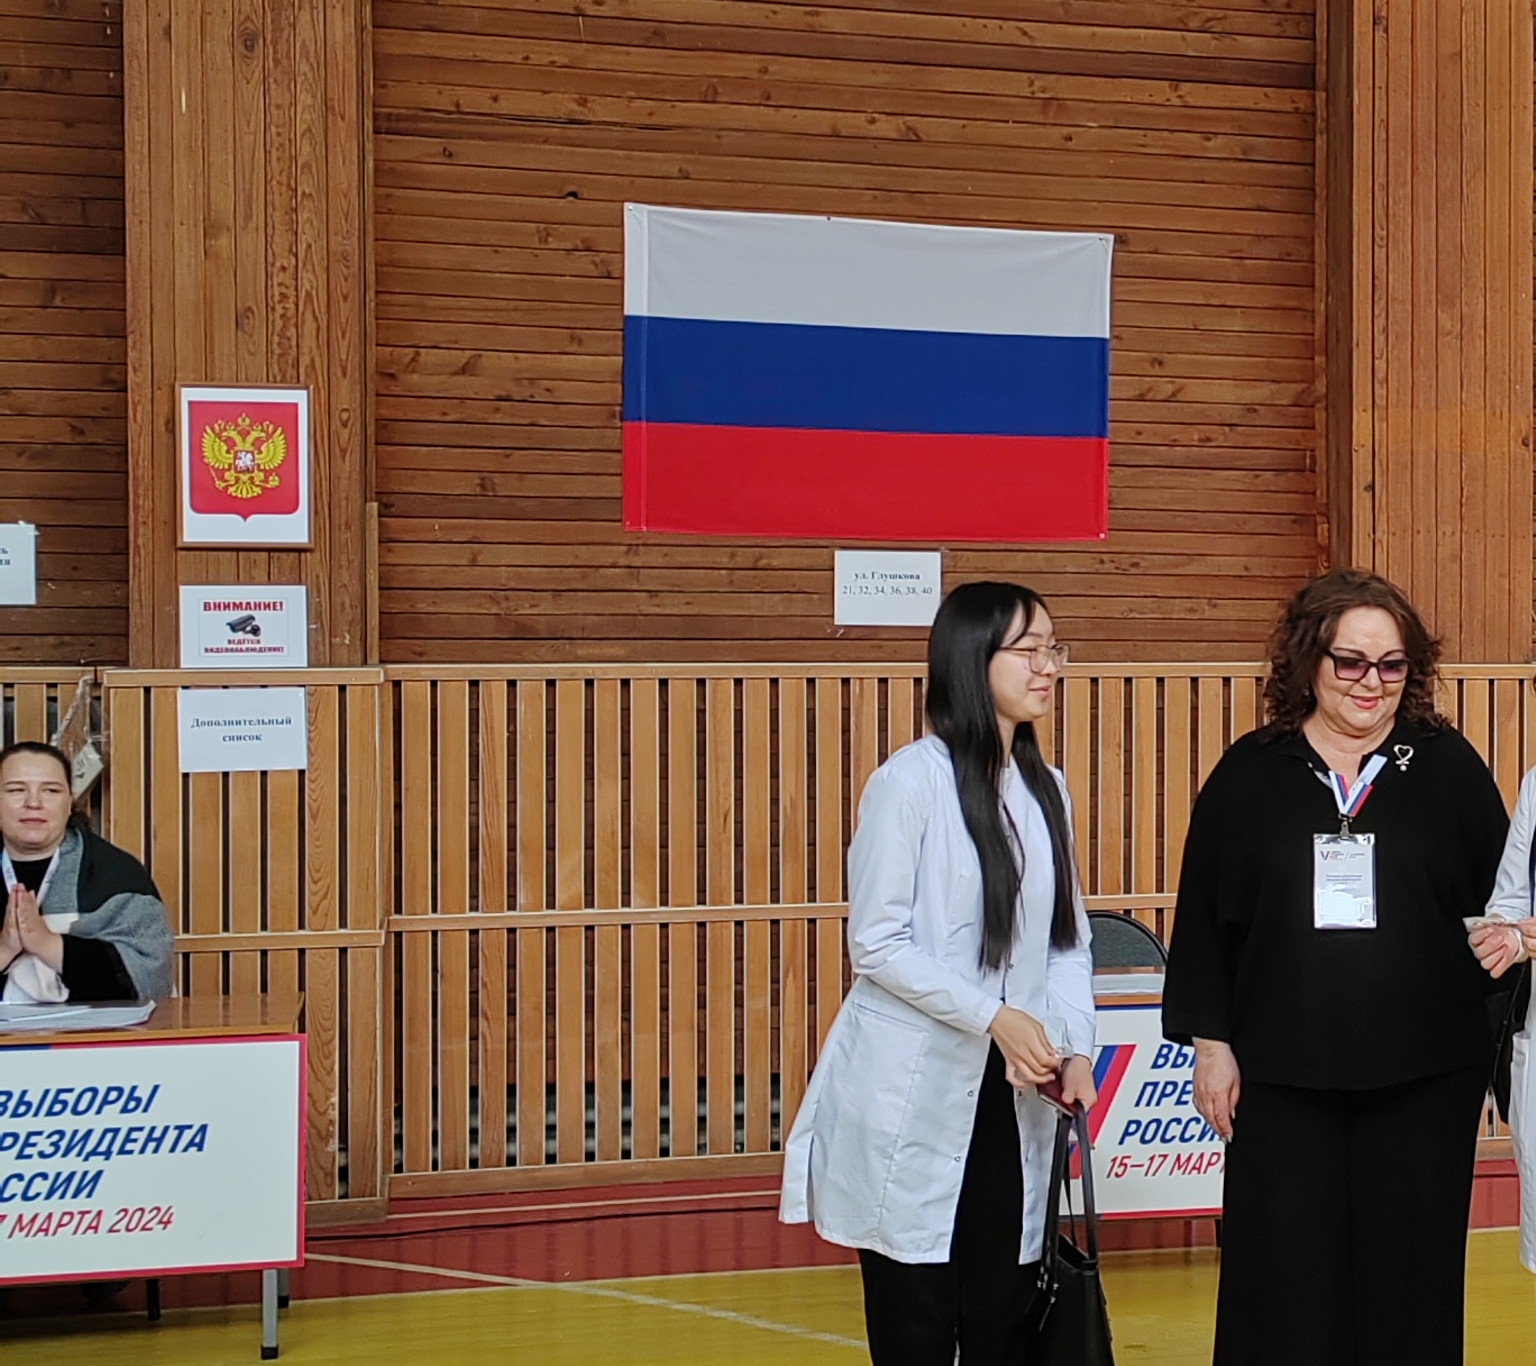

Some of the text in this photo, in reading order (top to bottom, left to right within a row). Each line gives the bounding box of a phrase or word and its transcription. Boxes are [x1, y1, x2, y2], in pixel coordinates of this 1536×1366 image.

[854, 571, 920, 581] ул. Глушкова
[842, 585, 856, 595] 21,
[859, 585, 871, 595] 32,
[921, 586, 933, 595] 40
[203, 601, 284, 611] ВНИМАНИЕ!
[191, 716, 292, 728] Дополнительный
[222, 734, 262, 742] список
[1118, 1116, 1216, 1146] РОССИ
[0, 1123, 209, 1162] РЕЗИДЕНТА
[1169, 1151, 1225, 1176] МАР
[0, 1169, 105, 1203] ССИИ
[7, 1209, 104, 1239] МАРТА
[107, 1205, 175, 1234] 2024
